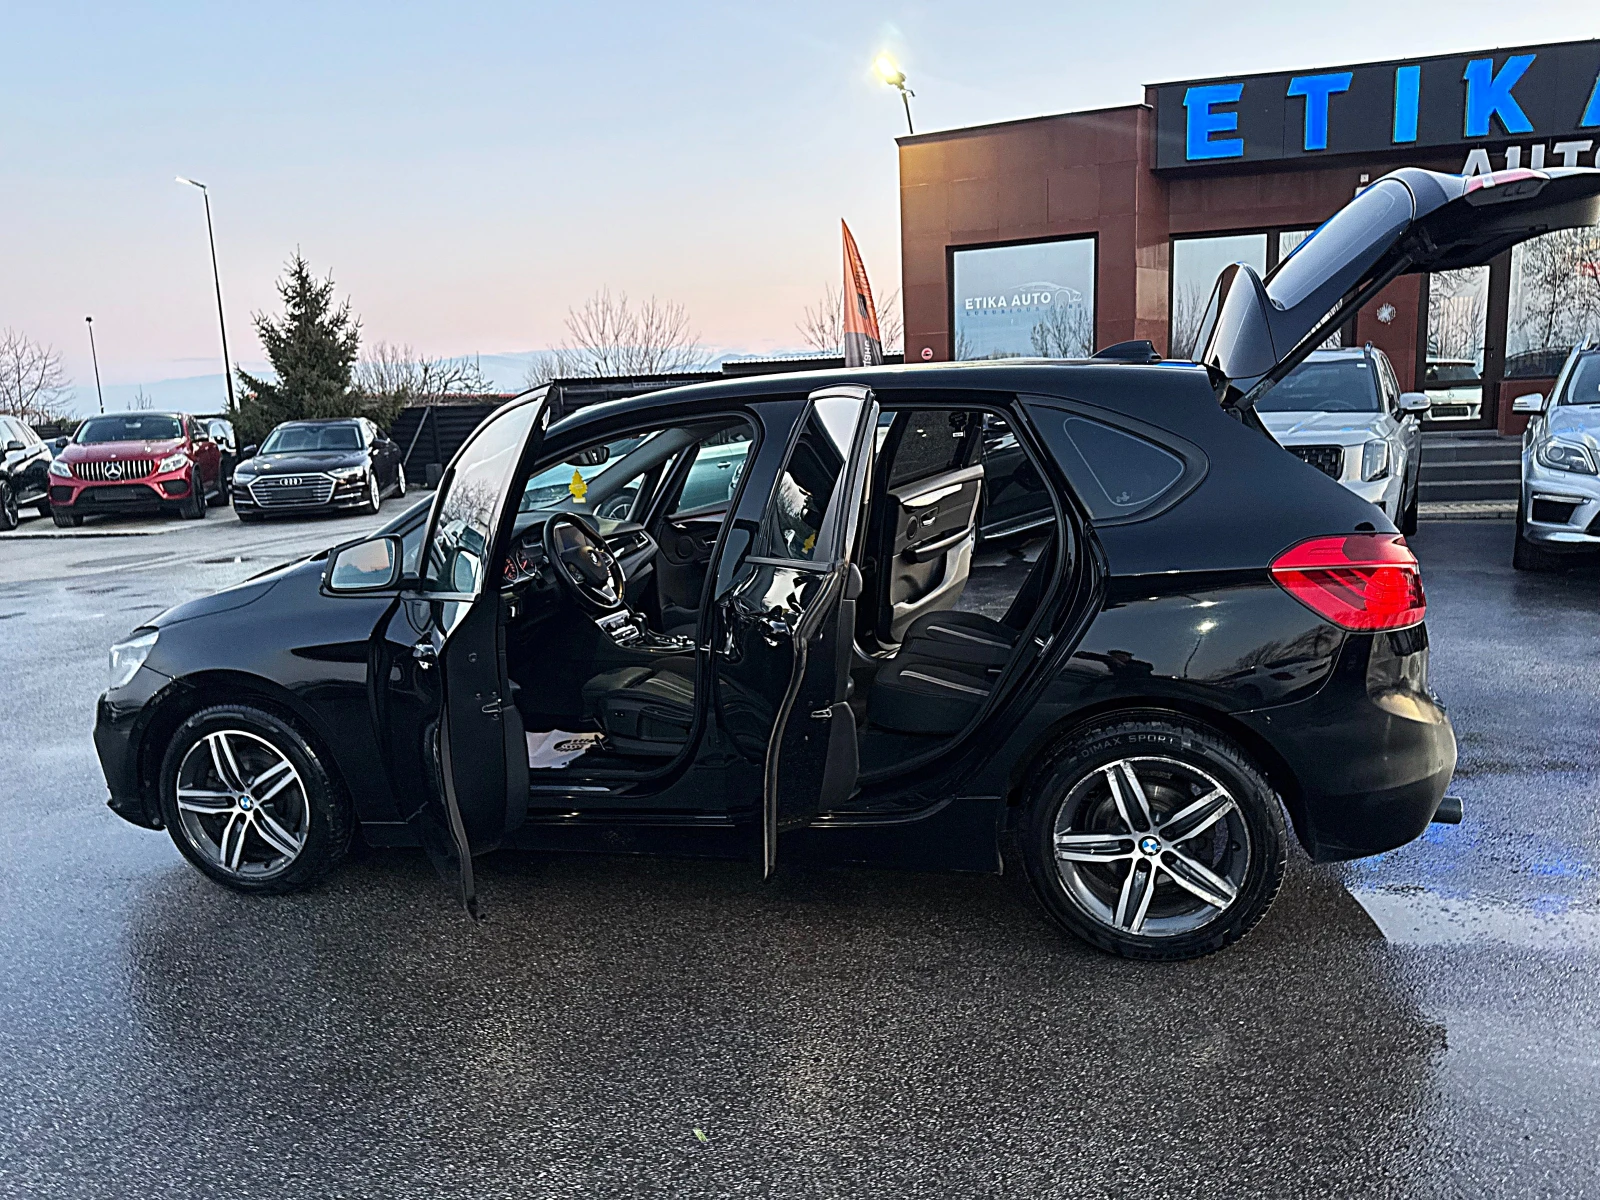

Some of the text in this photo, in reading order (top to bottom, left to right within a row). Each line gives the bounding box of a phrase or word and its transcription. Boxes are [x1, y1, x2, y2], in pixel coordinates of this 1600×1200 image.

[1183, 54, 1600, 161] ETIK
[965, 291, 1051, 310] ETIKA AUTO
[1081, 734, 1174, 758] DIMAX SPORT
